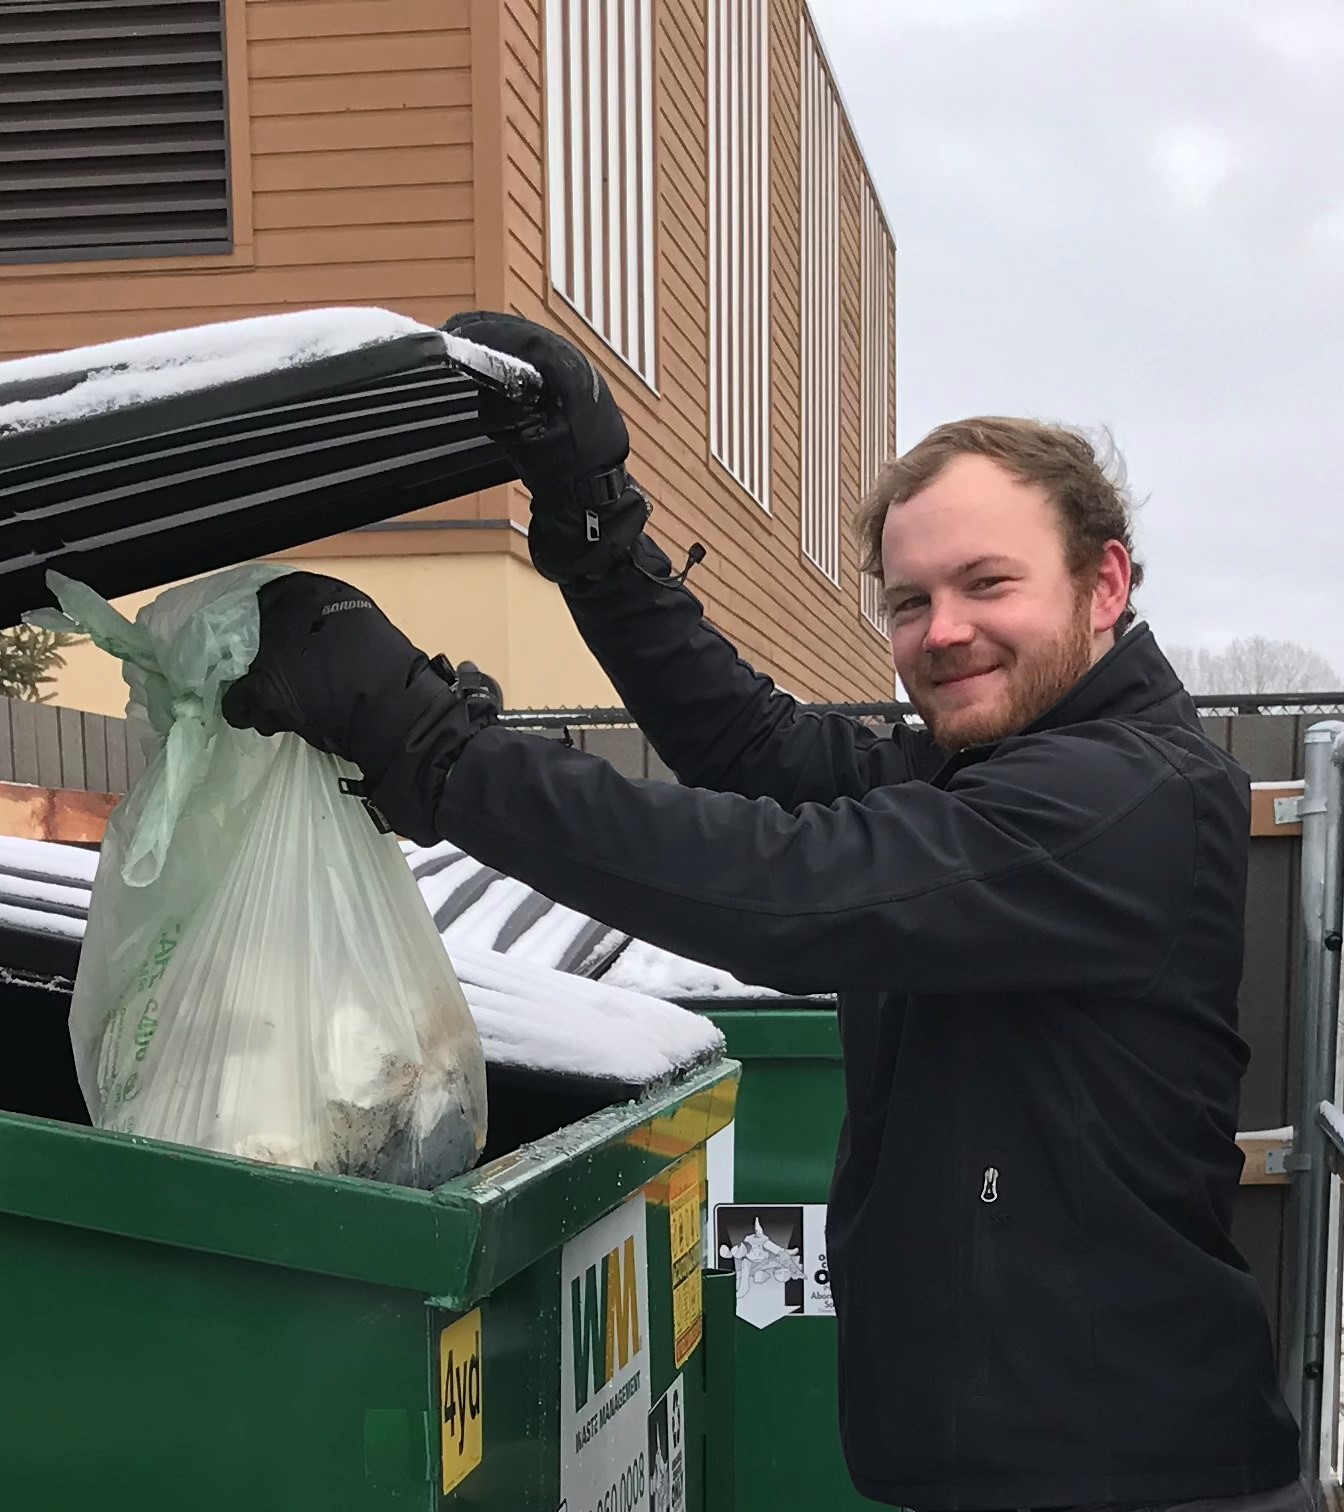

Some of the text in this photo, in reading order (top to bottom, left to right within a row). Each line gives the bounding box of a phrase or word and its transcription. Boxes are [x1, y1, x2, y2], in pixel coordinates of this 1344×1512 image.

[570, 1235, 641, 1413] WM
[811, 1291, 833, 1300] Abon
[444, 1330, 480, 1456] 4yd
[575, 1369, 641, 1454] WASTE MANAGEMENT
